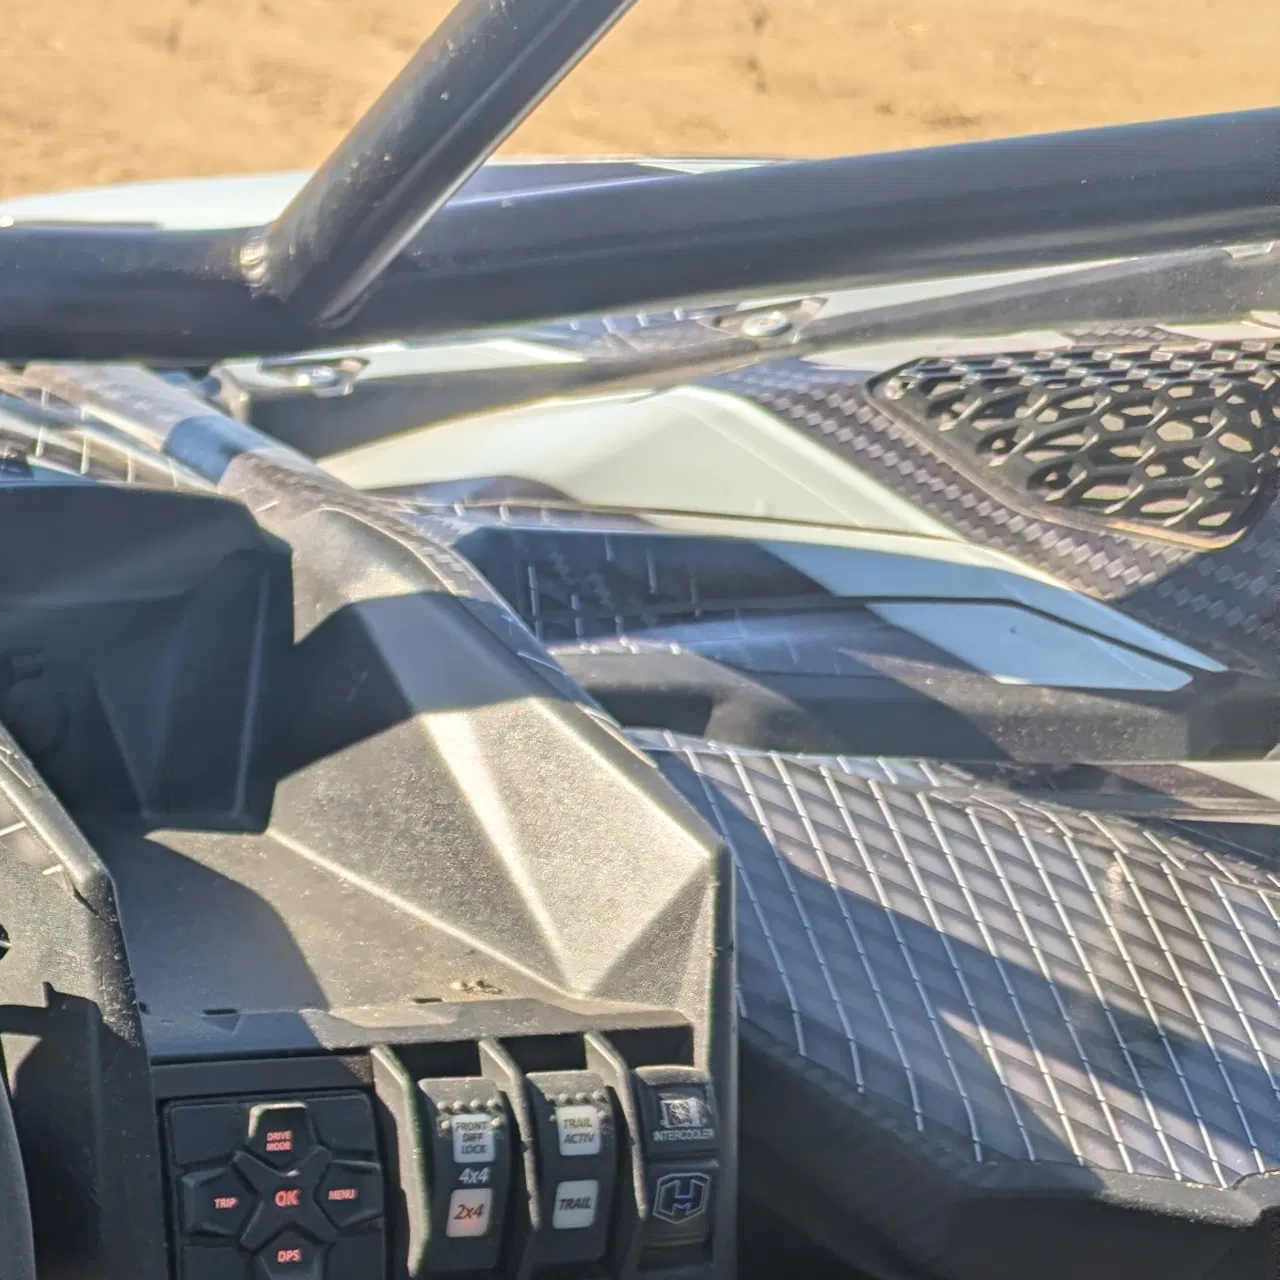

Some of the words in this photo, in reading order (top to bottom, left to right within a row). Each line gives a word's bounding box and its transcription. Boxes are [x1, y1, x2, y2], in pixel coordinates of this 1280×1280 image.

[455, 1121, 487, 1132] FRONT
[563, 1117, 593, 1129] TRAIL
[266, 1131, 292, 1141] DRIVE
[462, 1133, 483, 1142] DIFF
[563, 1132, 595, 1145] ACTIV
[652, 1128, 714, 1141] INTERCOOLER
[266, 1142, 292, 1151] MODE
[461, 1144, 487, 1155] LOCK
[459, 1166, 490, 1184] 4x4
[275, 1189, 300, 1207] OK
[328, 1189, 357, 1200] MENU
[214, 1197, 238, 1209] TRIP
[559, 1199, 591, 1210] TRAIL
[453, 1204, 485, 1220] 2x4
[277, 1249, 301, 1263] DPS
